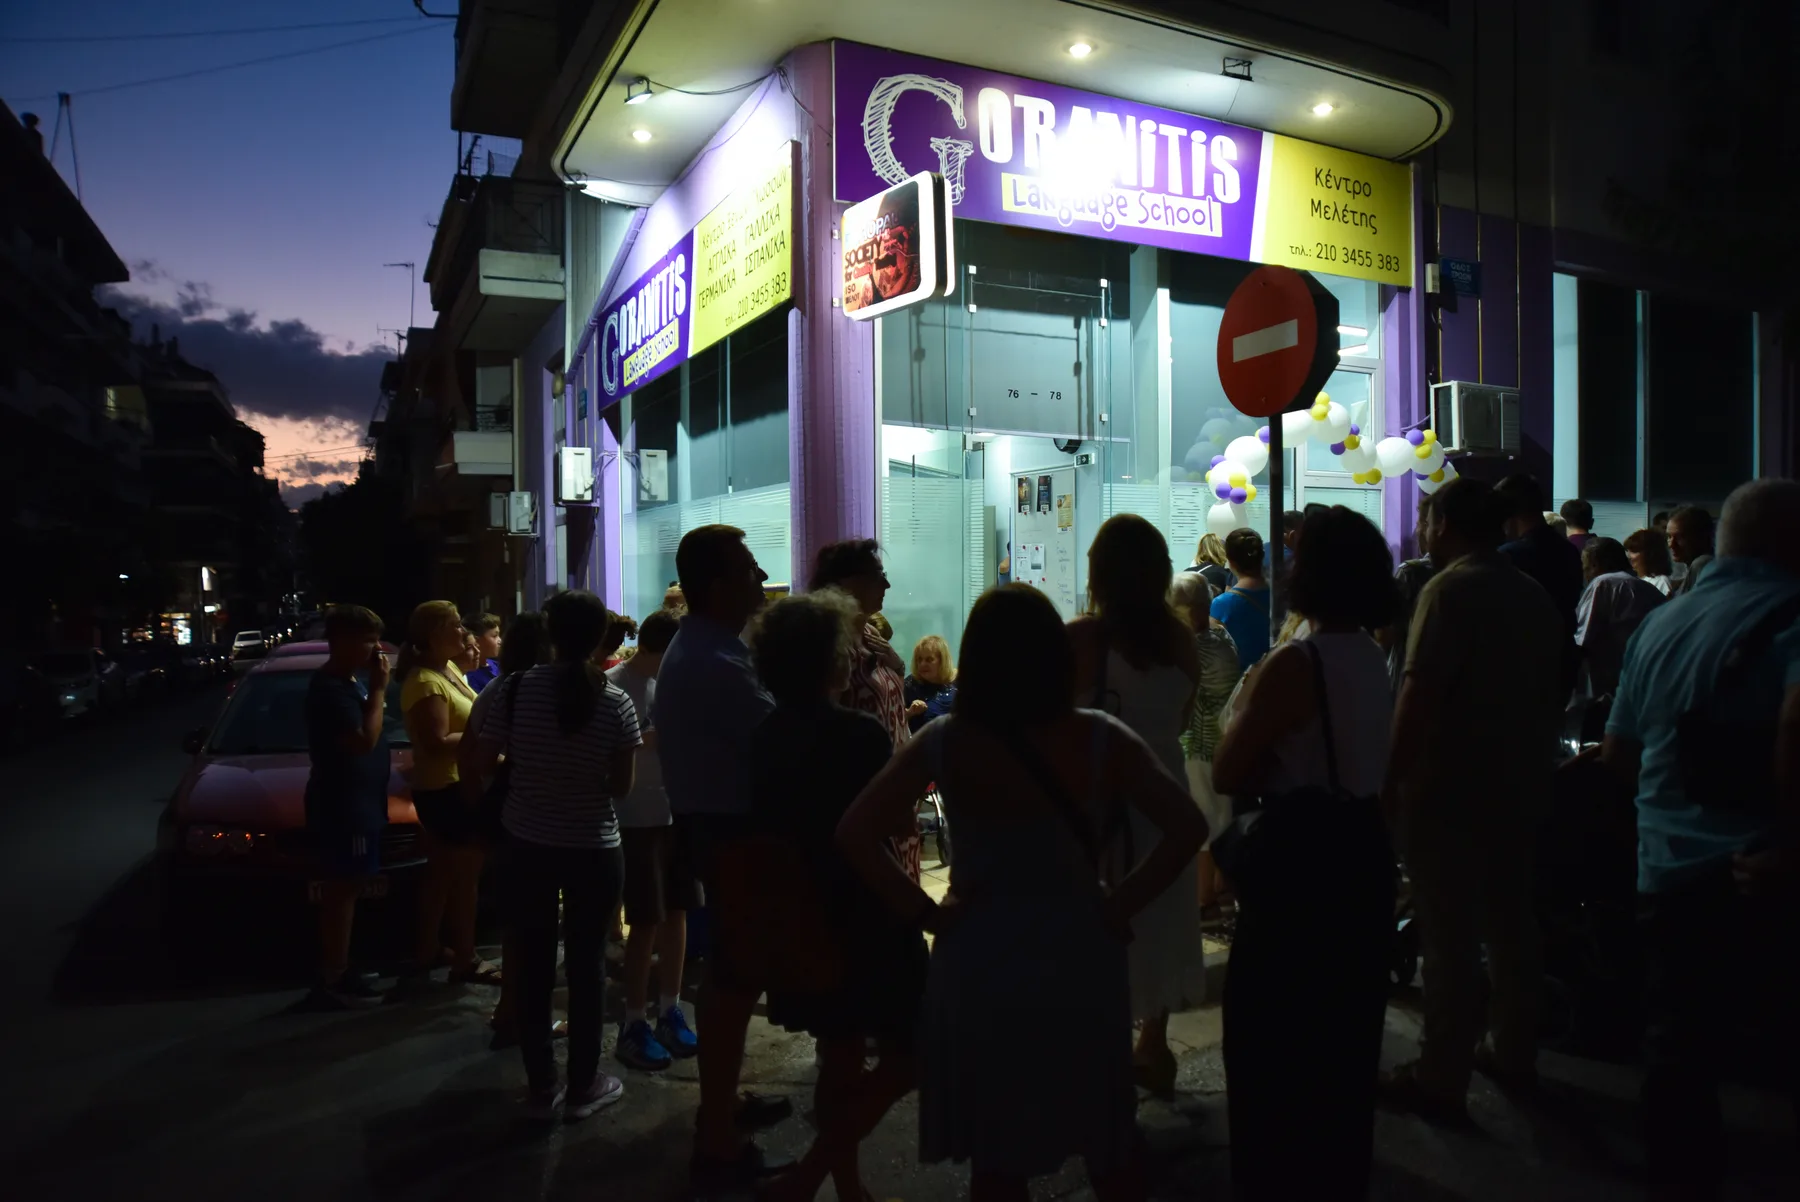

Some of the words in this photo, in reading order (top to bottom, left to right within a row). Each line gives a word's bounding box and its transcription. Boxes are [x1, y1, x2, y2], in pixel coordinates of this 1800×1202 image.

[1314, 167, 1372, 200] Κέντρο
[1138, 191, 1213, 232] School
[1310, 198, 1378, 235] Μελέτης
[845, 235, 883, 270] SOCIETY
[1316, 242, 1337, 262] 210
[1342, 246, 1373, 268] 3455
[1377, 253, 1400, 272] 383
[698, 268, 737, 311] ΓΕΡΜΑΝΙΚΑ
[745, 230, 786, 276] ΙΣΠΑΝΙΚΑ
[738, 296, 748, 319] 210
[751, 282, 769, 310] 3455
[771, 271, 787, 298] 383
[846, 283, 856, 295] ISO
[1008, 388, 1019, 399] 76
[1049, 390, 1062, 401] 78
